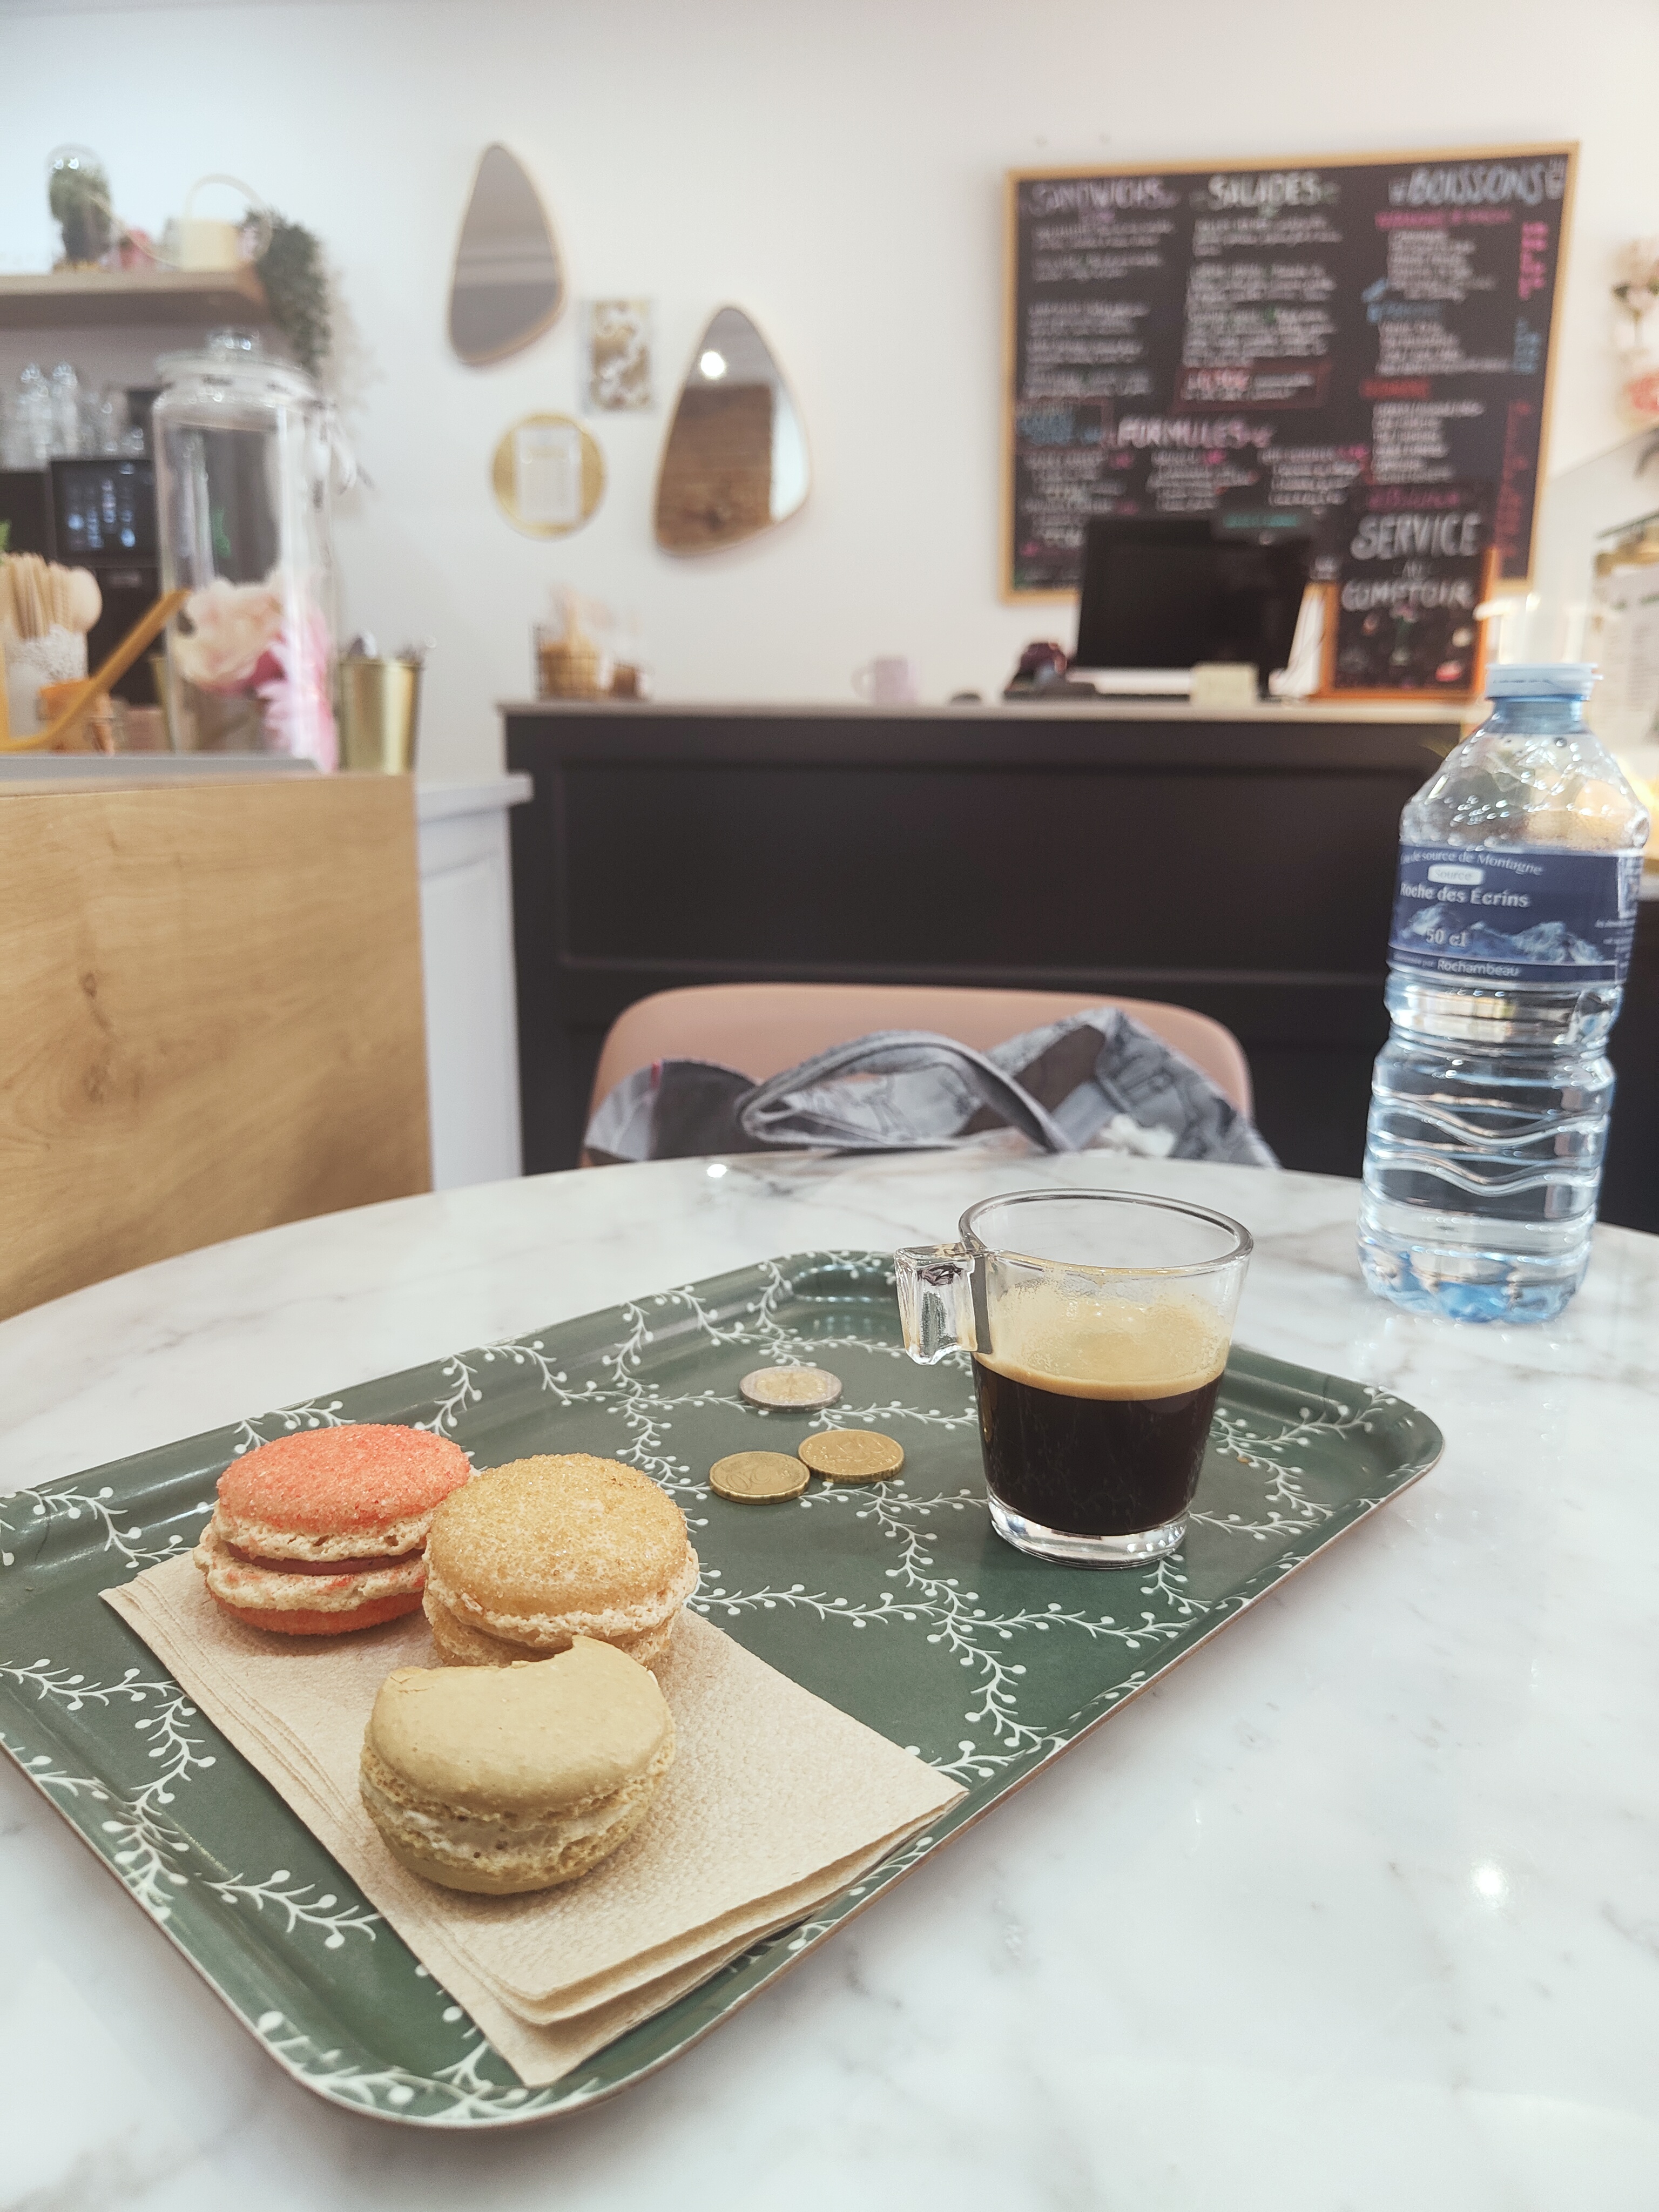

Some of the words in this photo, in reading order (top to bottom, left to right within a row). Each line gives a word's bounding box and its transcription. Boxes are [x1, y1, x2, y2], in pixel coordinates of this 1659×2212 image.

[1208, 172, 1322, 211] SALADES
[1351, 512, 1481, 561] SERVICE
[1341, 579, 1475, 611] COMPTOIR
[1421, 852, 1456, 862] source
[1459, 851, 1475, 863] de
[1477, 853, 1543, 875] Montagne
[1434, 869, 1473, 881] Source
[1400, 881, 1436, 900] Roche
[1437, 886, 1468, 903] des
[1470, 886, 1530, 908] Écrins
[1426, 927, 1446, 945] 50
[1449, 930, 1467, 948] cl
[1437, 957, 1521, 977] Rochambeau
